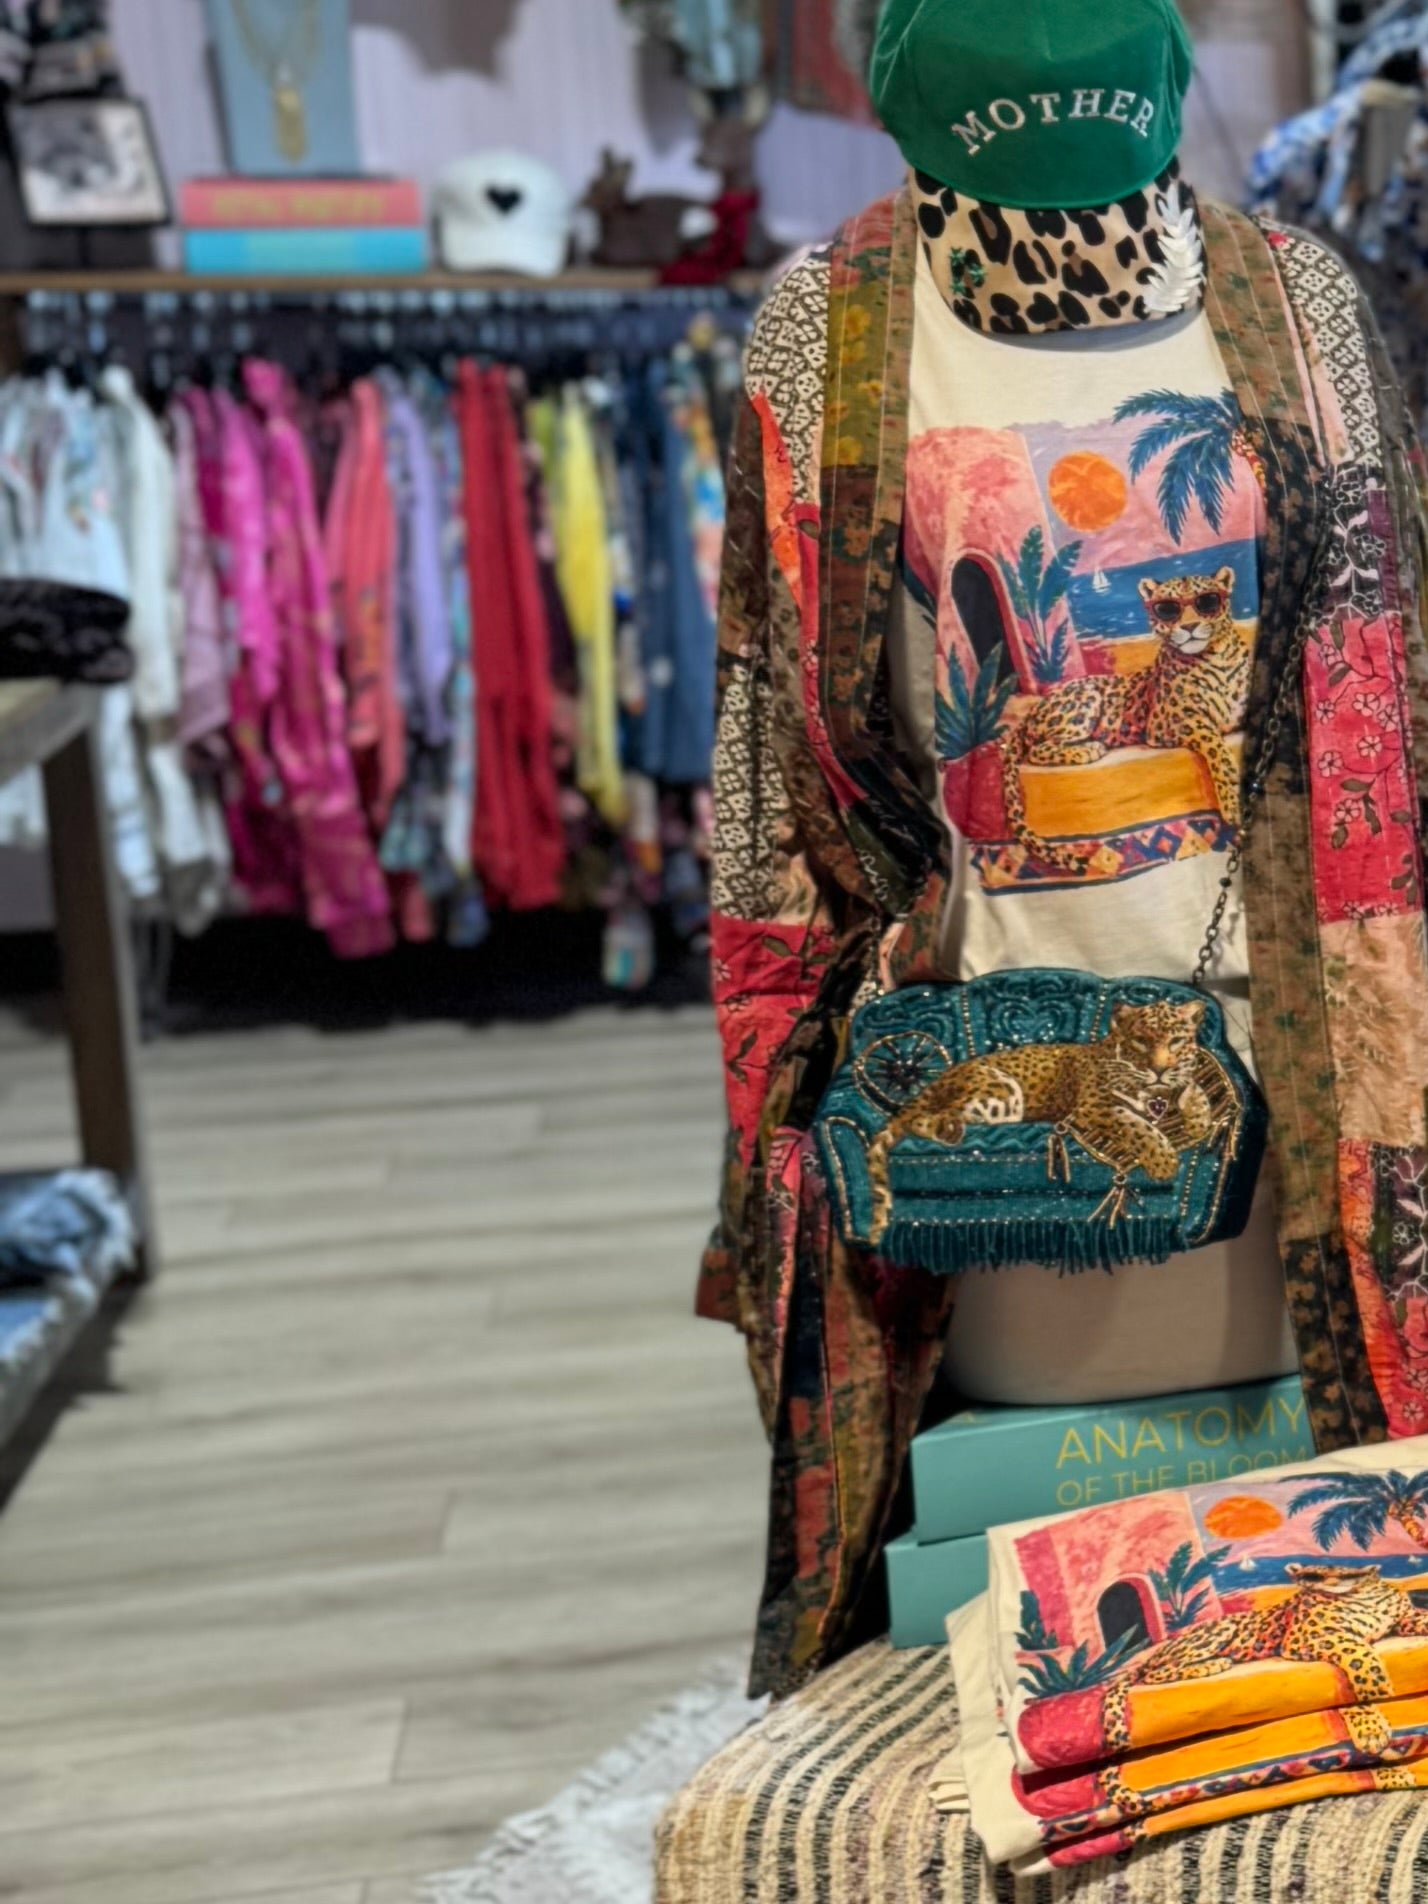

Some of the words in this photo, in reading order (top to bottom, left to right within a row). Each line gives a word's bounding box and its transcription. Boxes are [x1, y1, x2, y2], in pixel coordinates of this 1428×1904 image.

[952, 88, 1154, 155] MOTHER
[1056, 1396, 1305, 1470] ANATOMY
[1056, 1476, 1101, 1506] OF
[1111, 1464, 1176, 1496] THE
